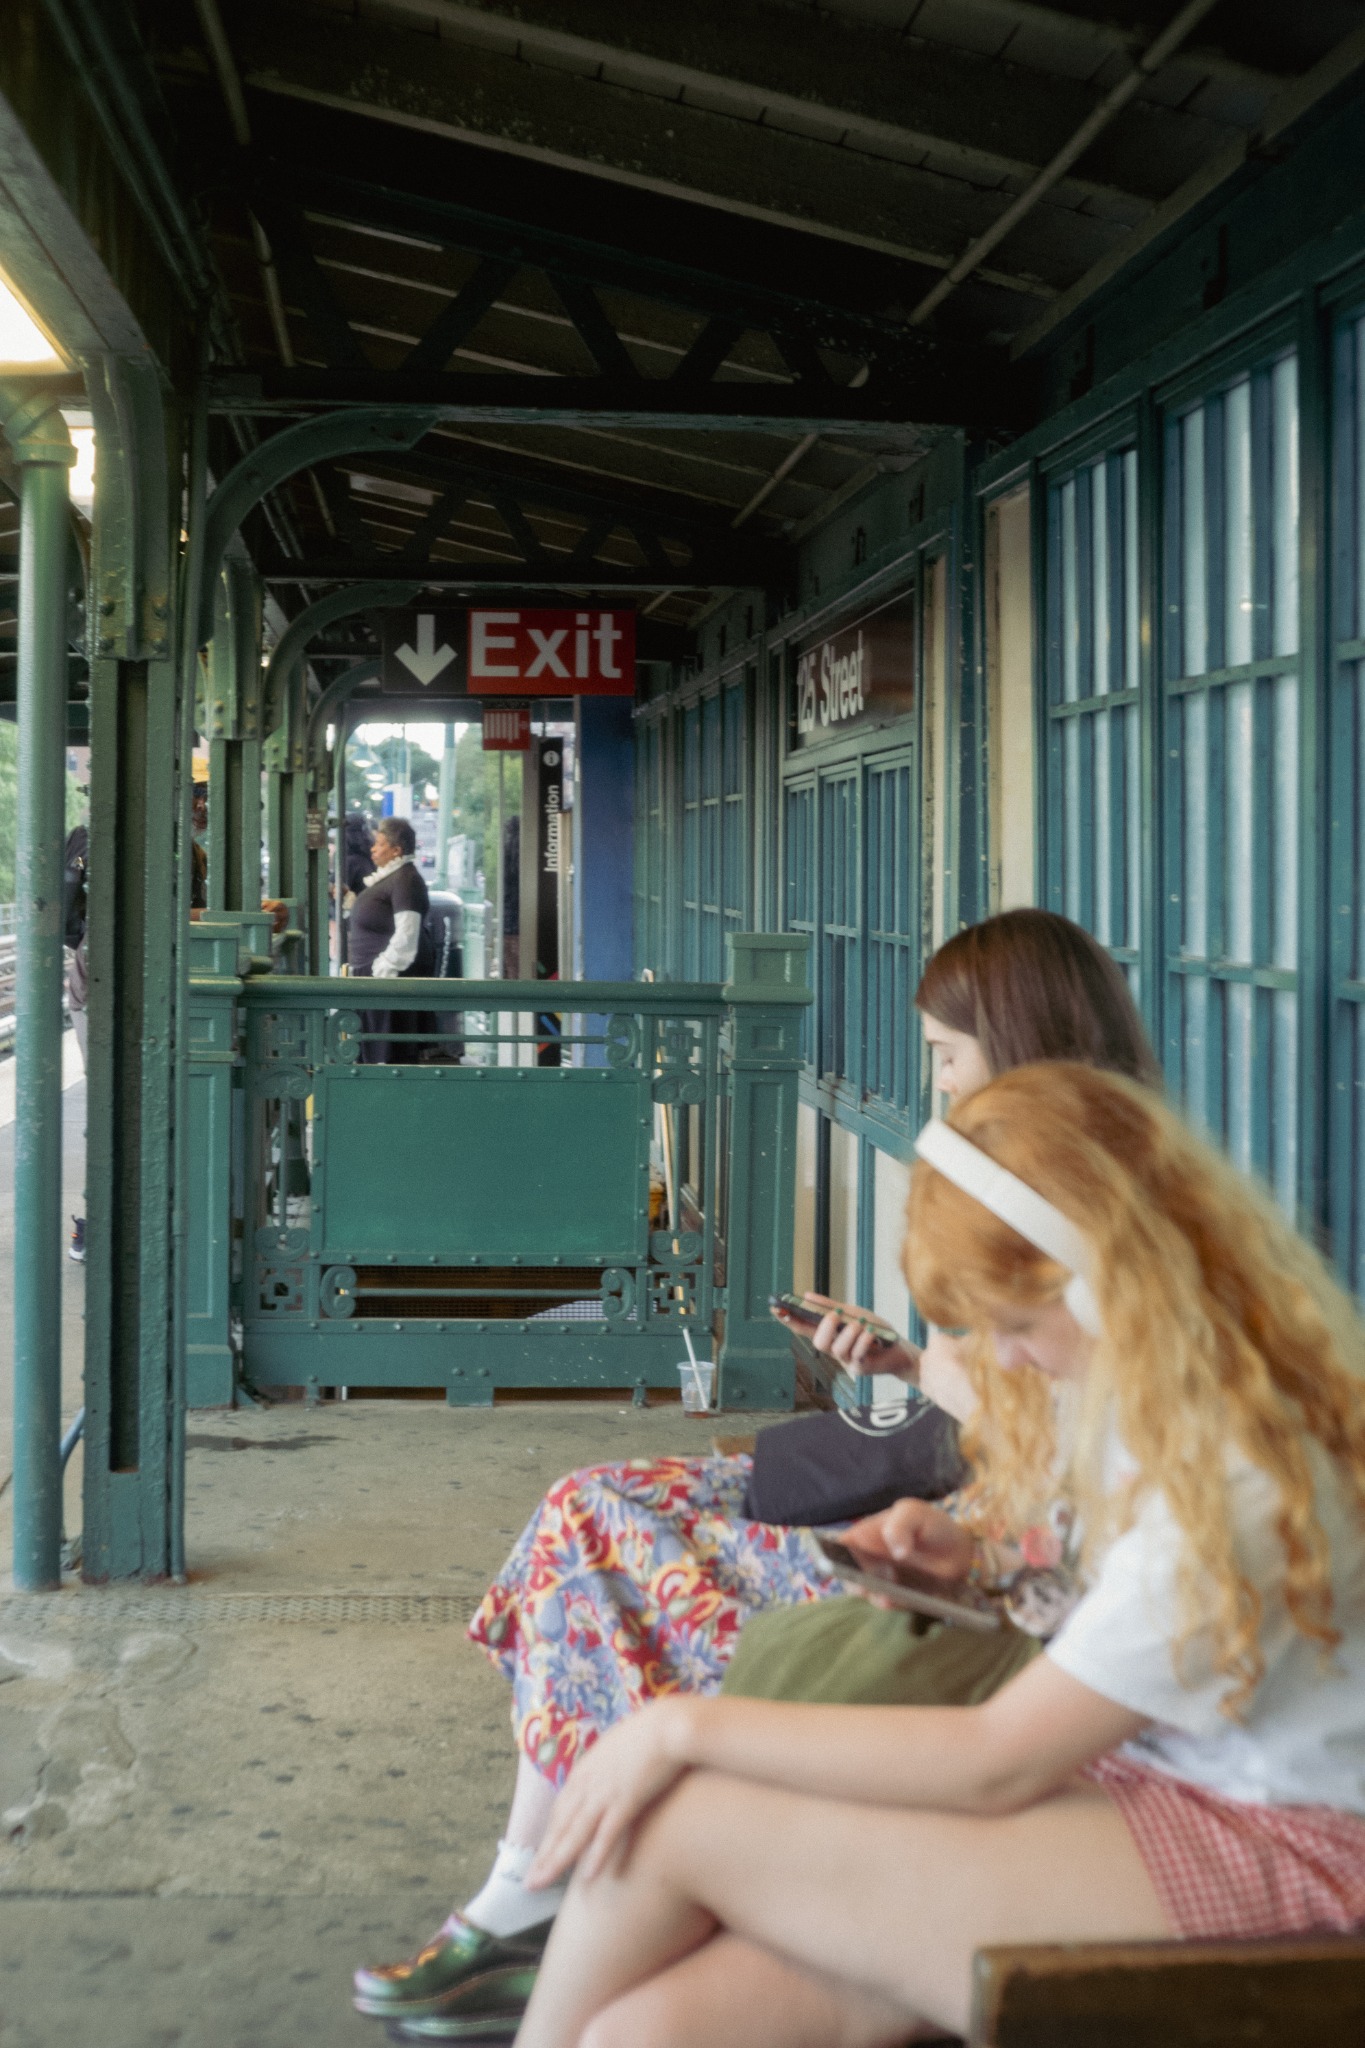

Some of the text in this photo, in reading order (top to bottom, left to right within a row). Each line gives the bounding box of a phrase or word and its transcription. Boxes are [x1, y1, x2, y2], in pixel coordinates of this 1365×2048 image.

[470, 611, 623, 679] Exit
[820, 629, 864, 728] Street
[543, 784, 560, 873] Information
